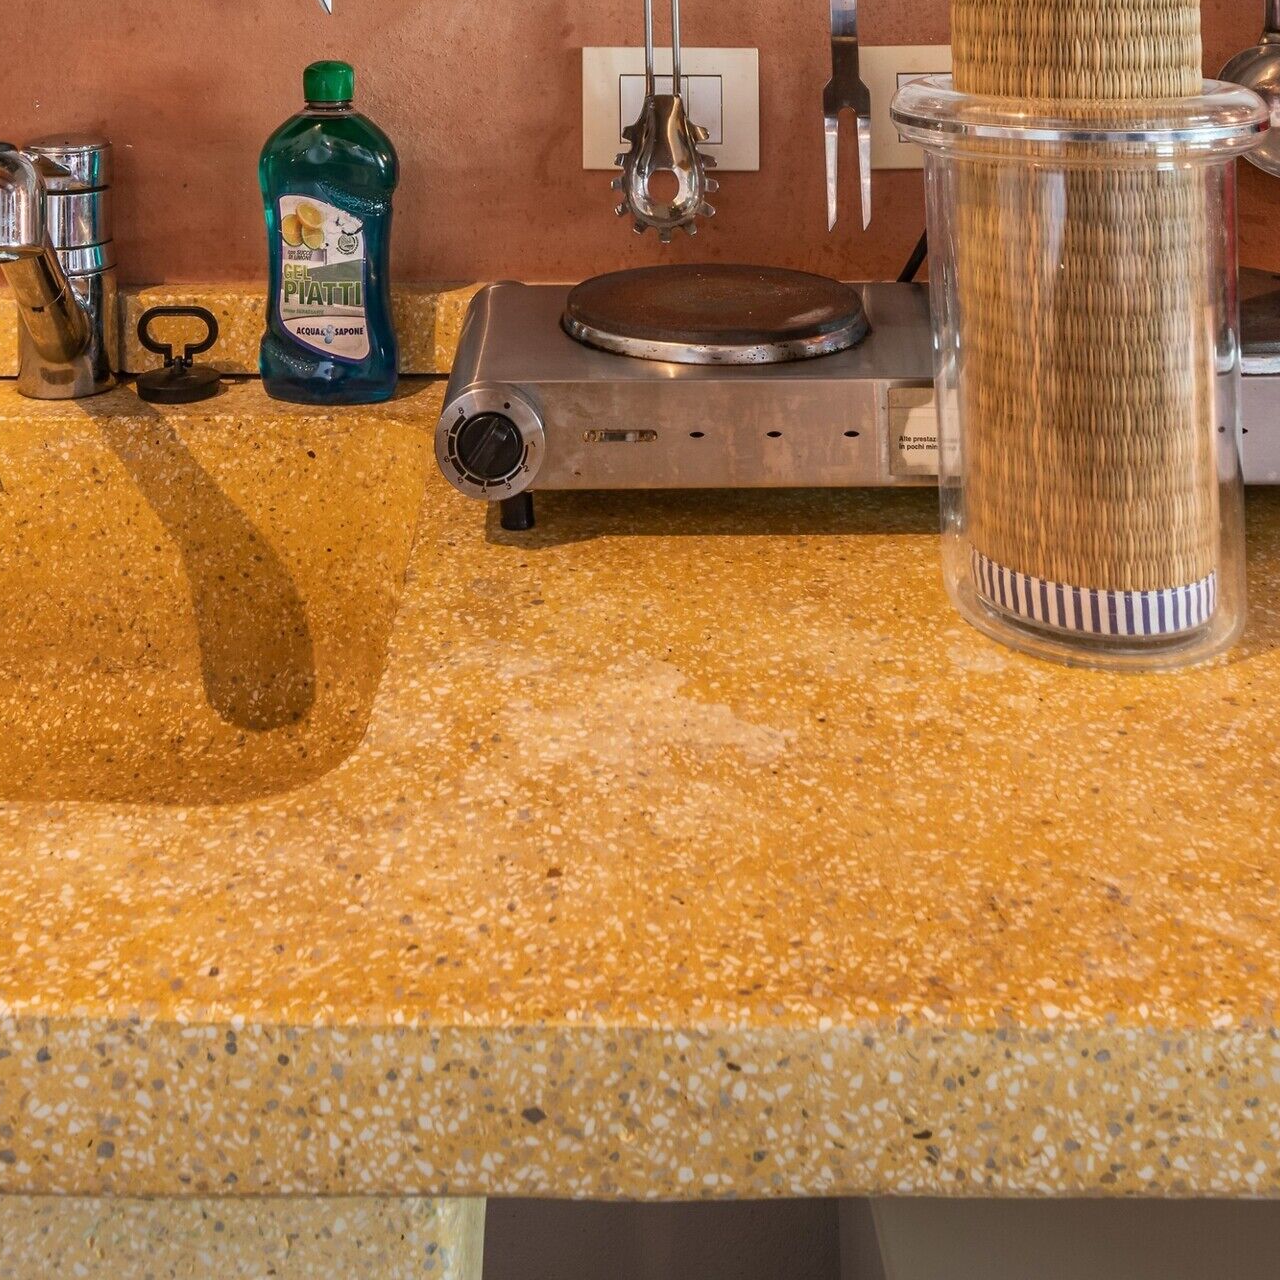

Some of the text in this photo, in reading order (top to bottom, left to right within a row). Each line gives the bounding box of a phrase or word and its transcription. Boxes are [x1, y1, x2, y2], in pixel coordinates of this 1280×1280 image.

[284, 264, 311, 280] GEL
[284, 281, 362, 307] PIATTI
[296, 327, 319, 335] ACQUA
[335, 327, 364, 336] SAPONE
[907, 443, 924, 451] pochi
[523, 464, 529, 472] 2
[505, 482, 512, 490] 3
